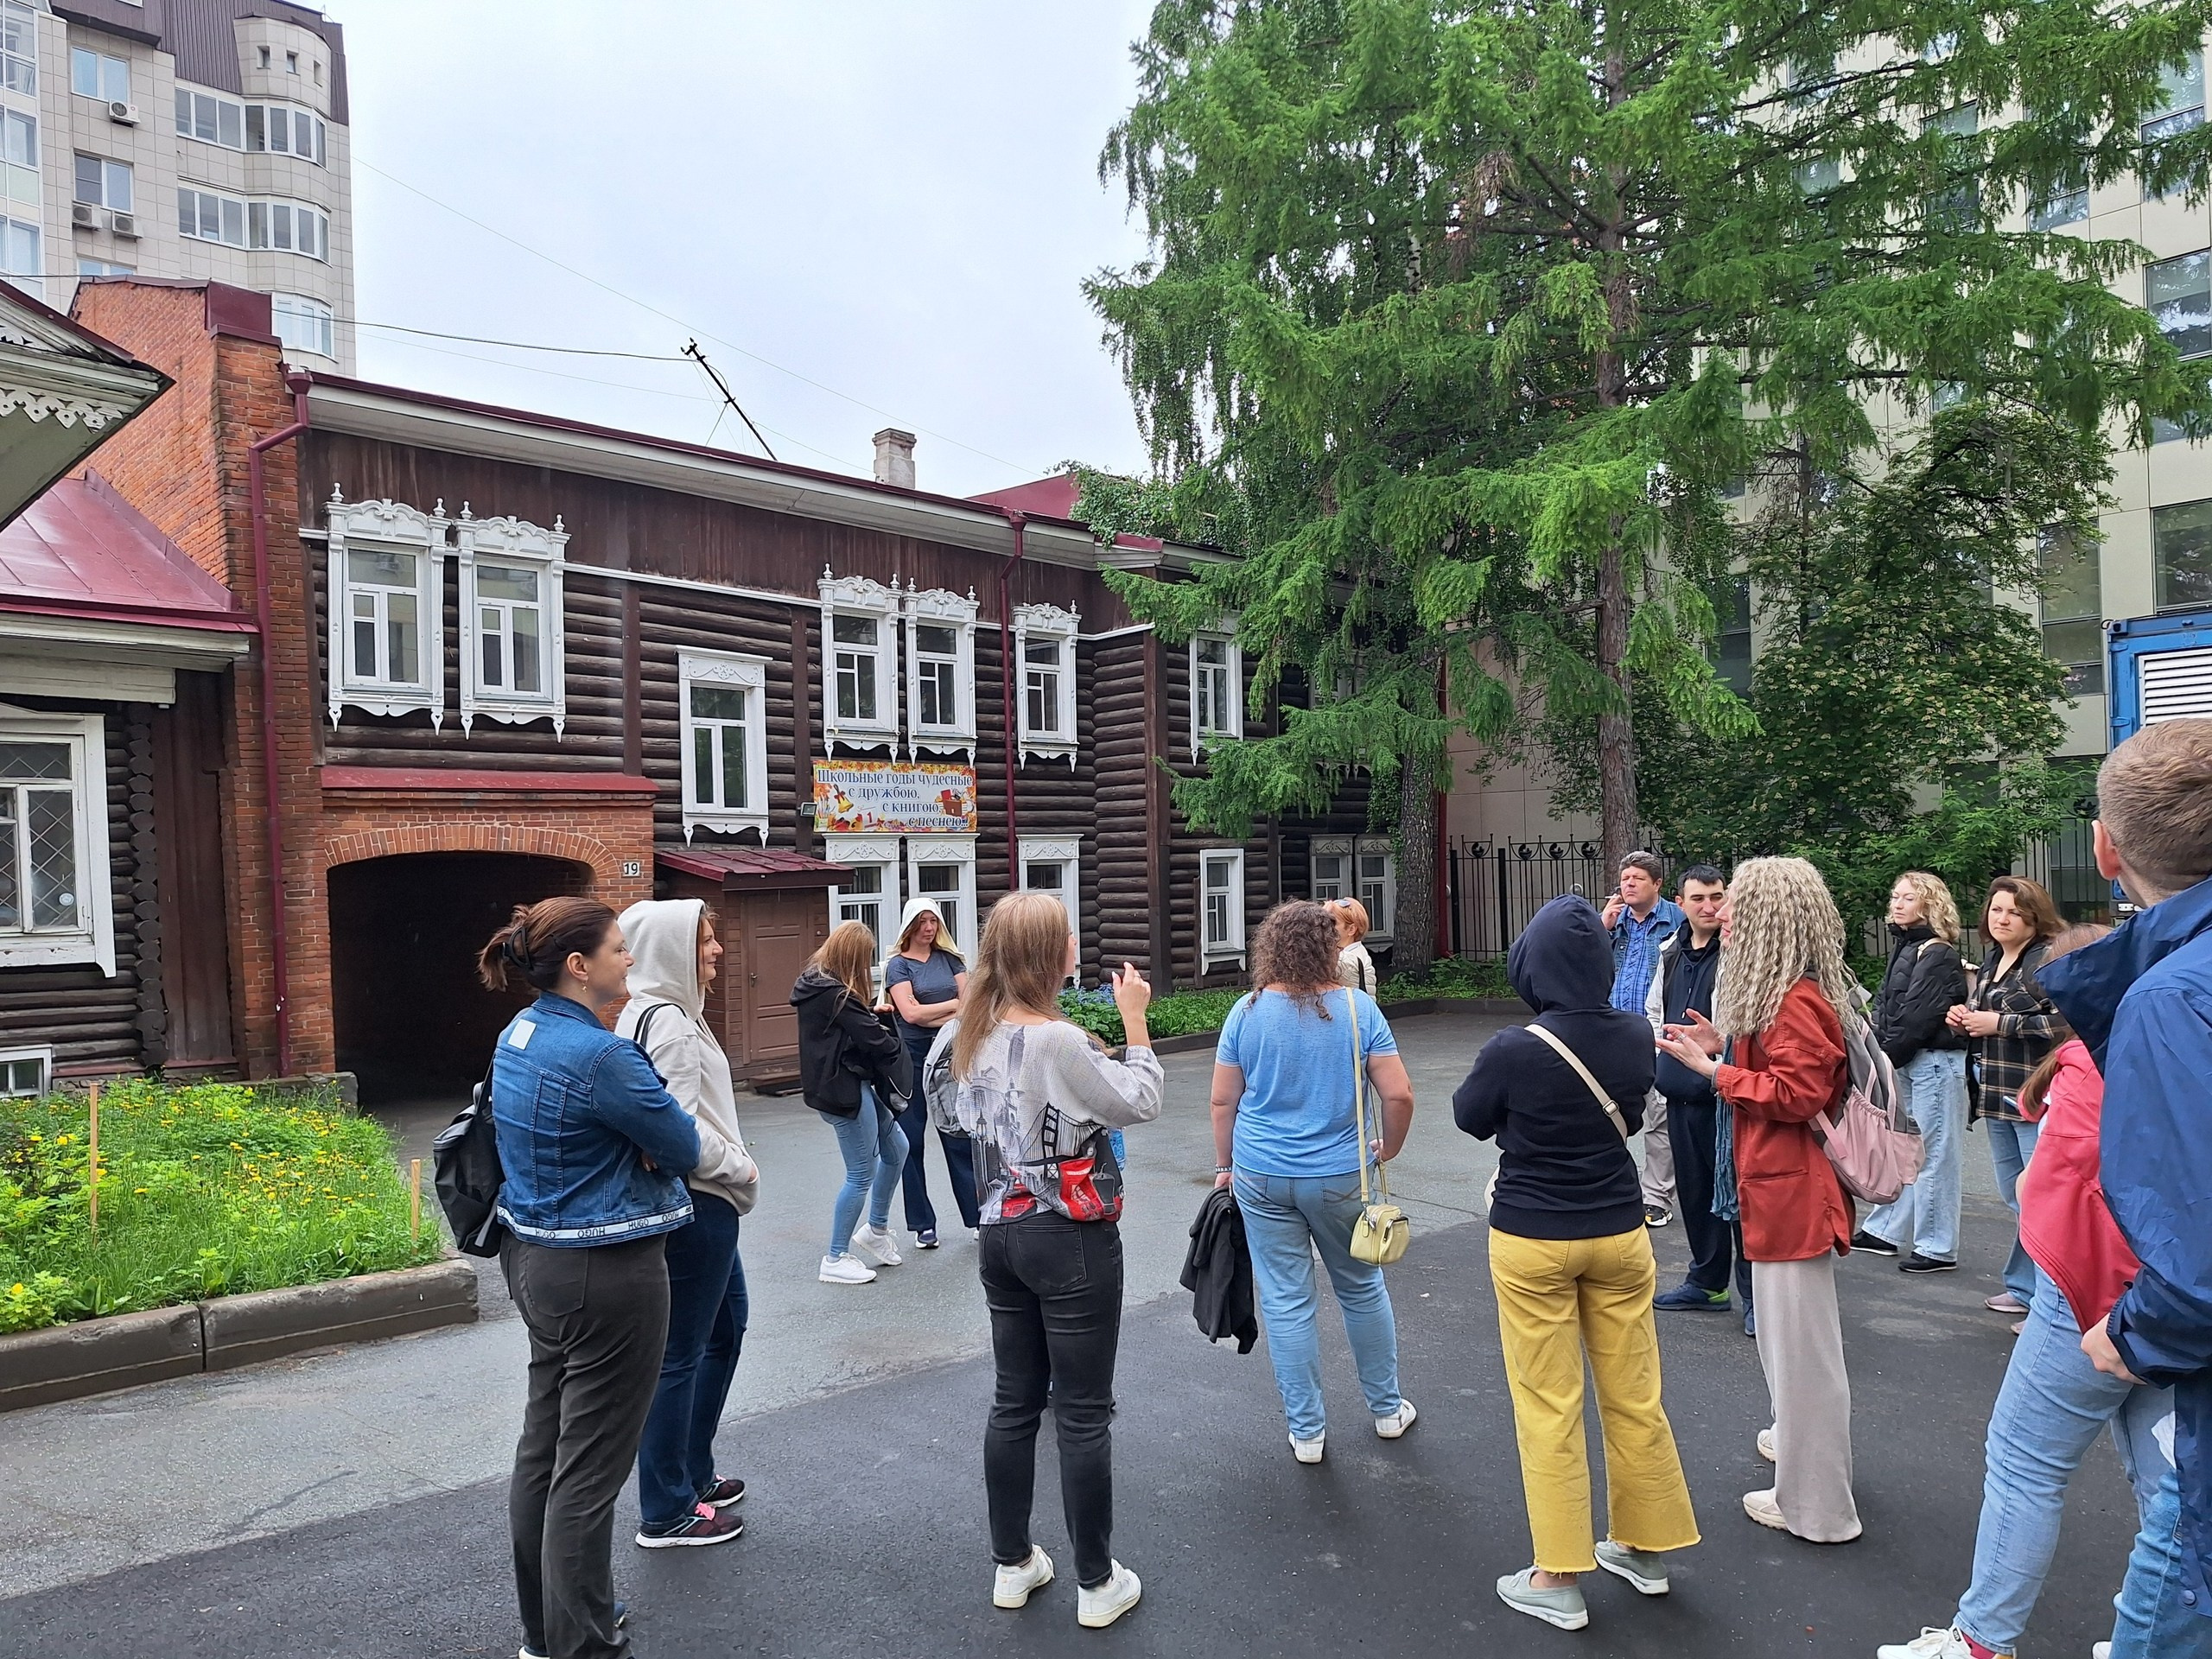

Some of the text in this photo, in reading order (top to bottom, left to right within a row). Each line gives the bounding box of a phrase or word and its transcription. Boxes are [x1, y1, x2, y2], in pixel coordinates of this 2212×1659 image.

[818, 770, 972, 788] Школьные годы чудесные
[849, 786, 919, 800] с дружбою,
[882, 803, 941, 813] с книгою,
[909, 817, 915, 827] с
[624, 862, 638, 874] 19
[628, 1217, 649, 1230] HUGO
[535, 1229, 556, 1239] HUGO
[577, 1227, 606, 1239] HUGO
